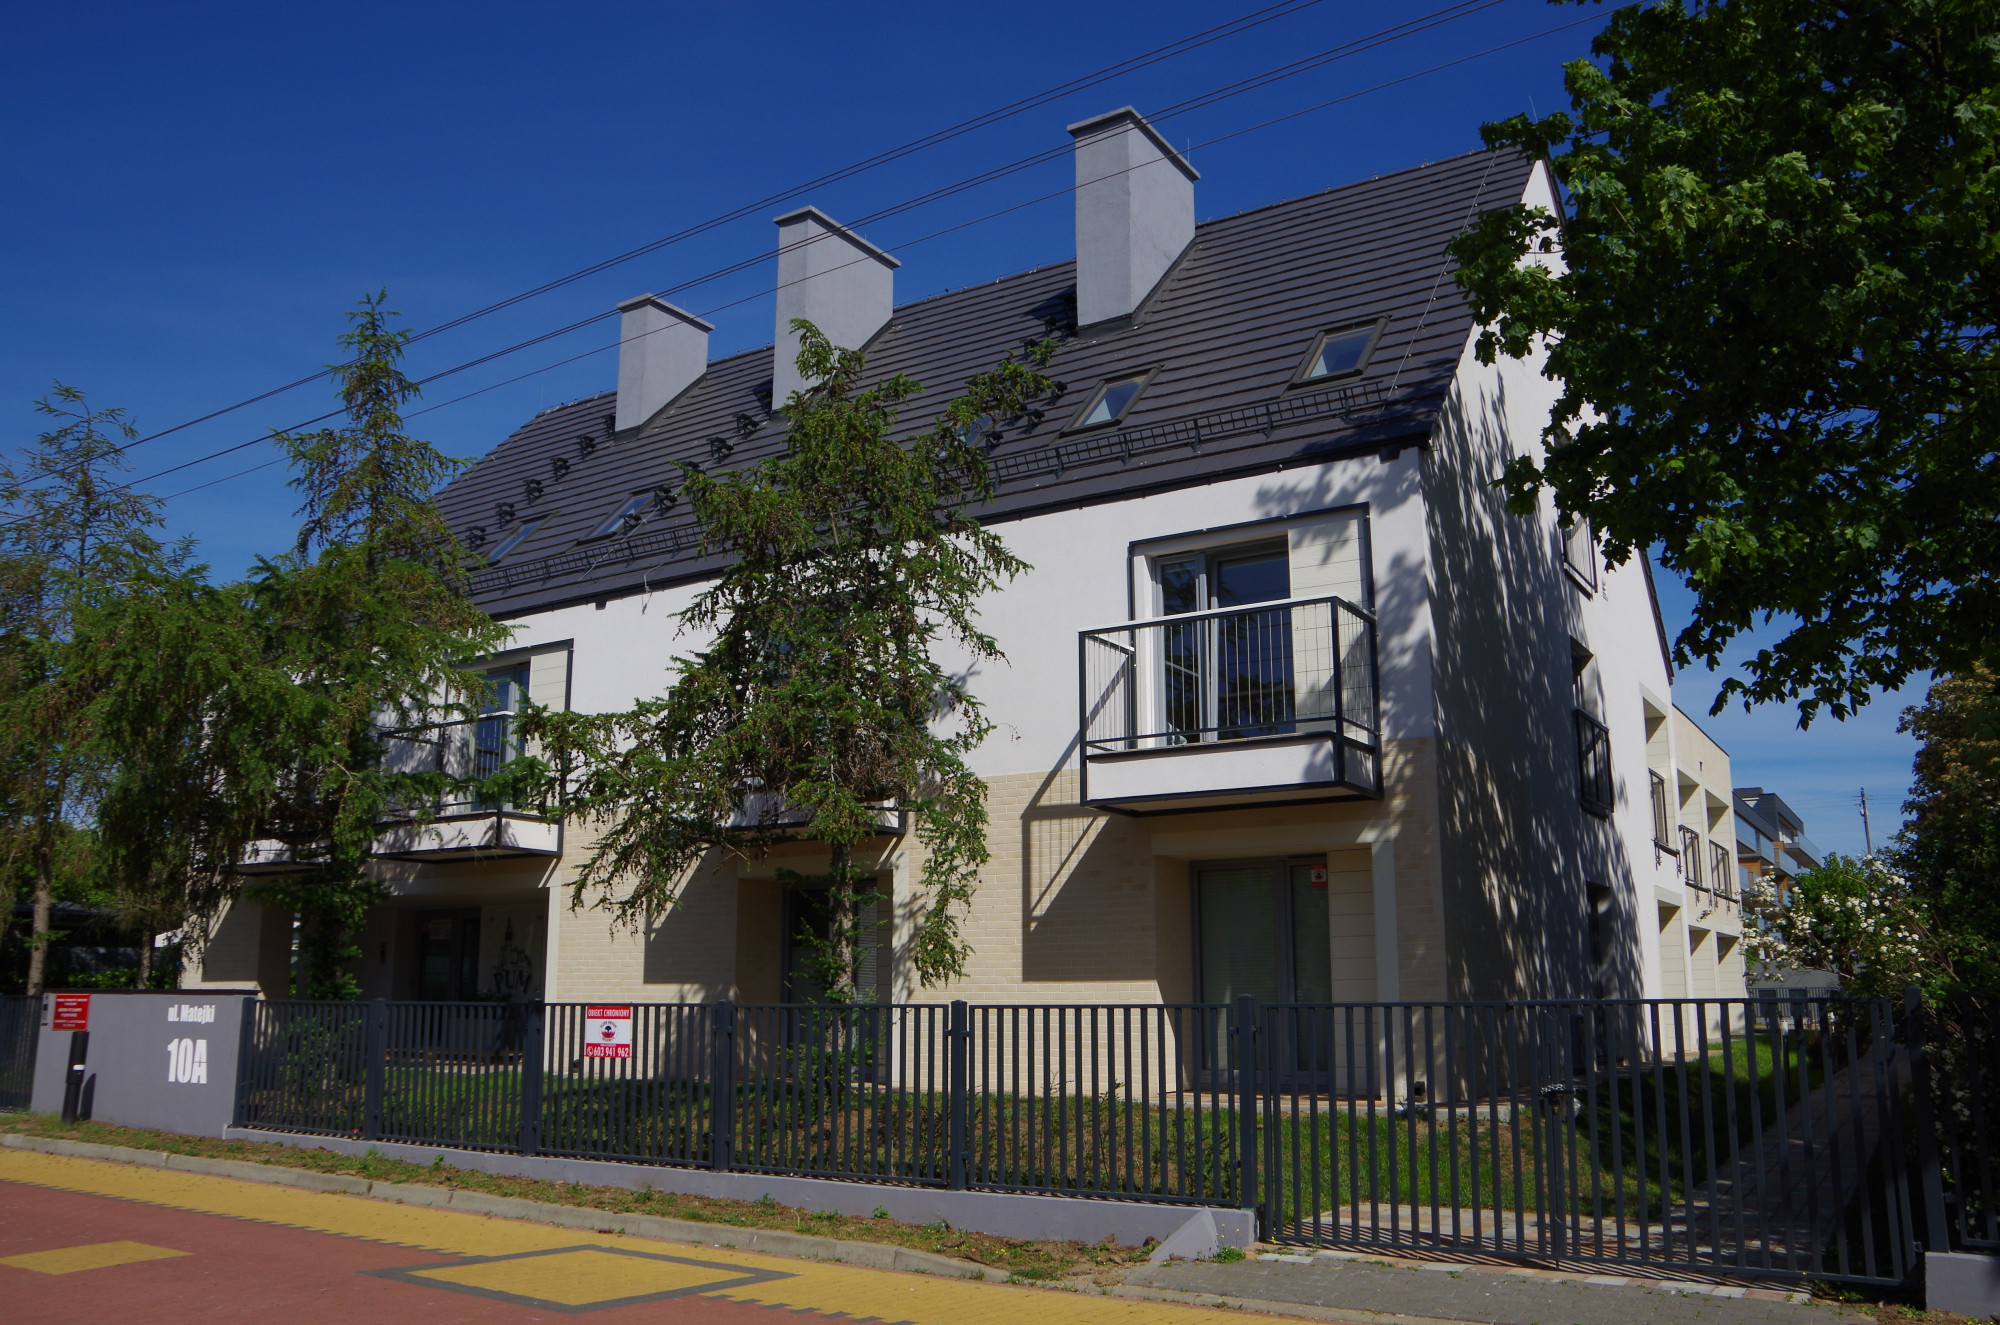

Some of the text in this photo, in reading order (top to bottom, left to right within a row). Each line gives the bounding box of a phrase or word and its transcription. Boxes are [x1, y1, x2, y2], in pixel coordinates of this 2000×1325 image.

[167, 1004, 216, 1024] ul. Matejki
[167, 1037, 208, 1085] 10A
[593, 1046, 629, 1057] 603 941 962
